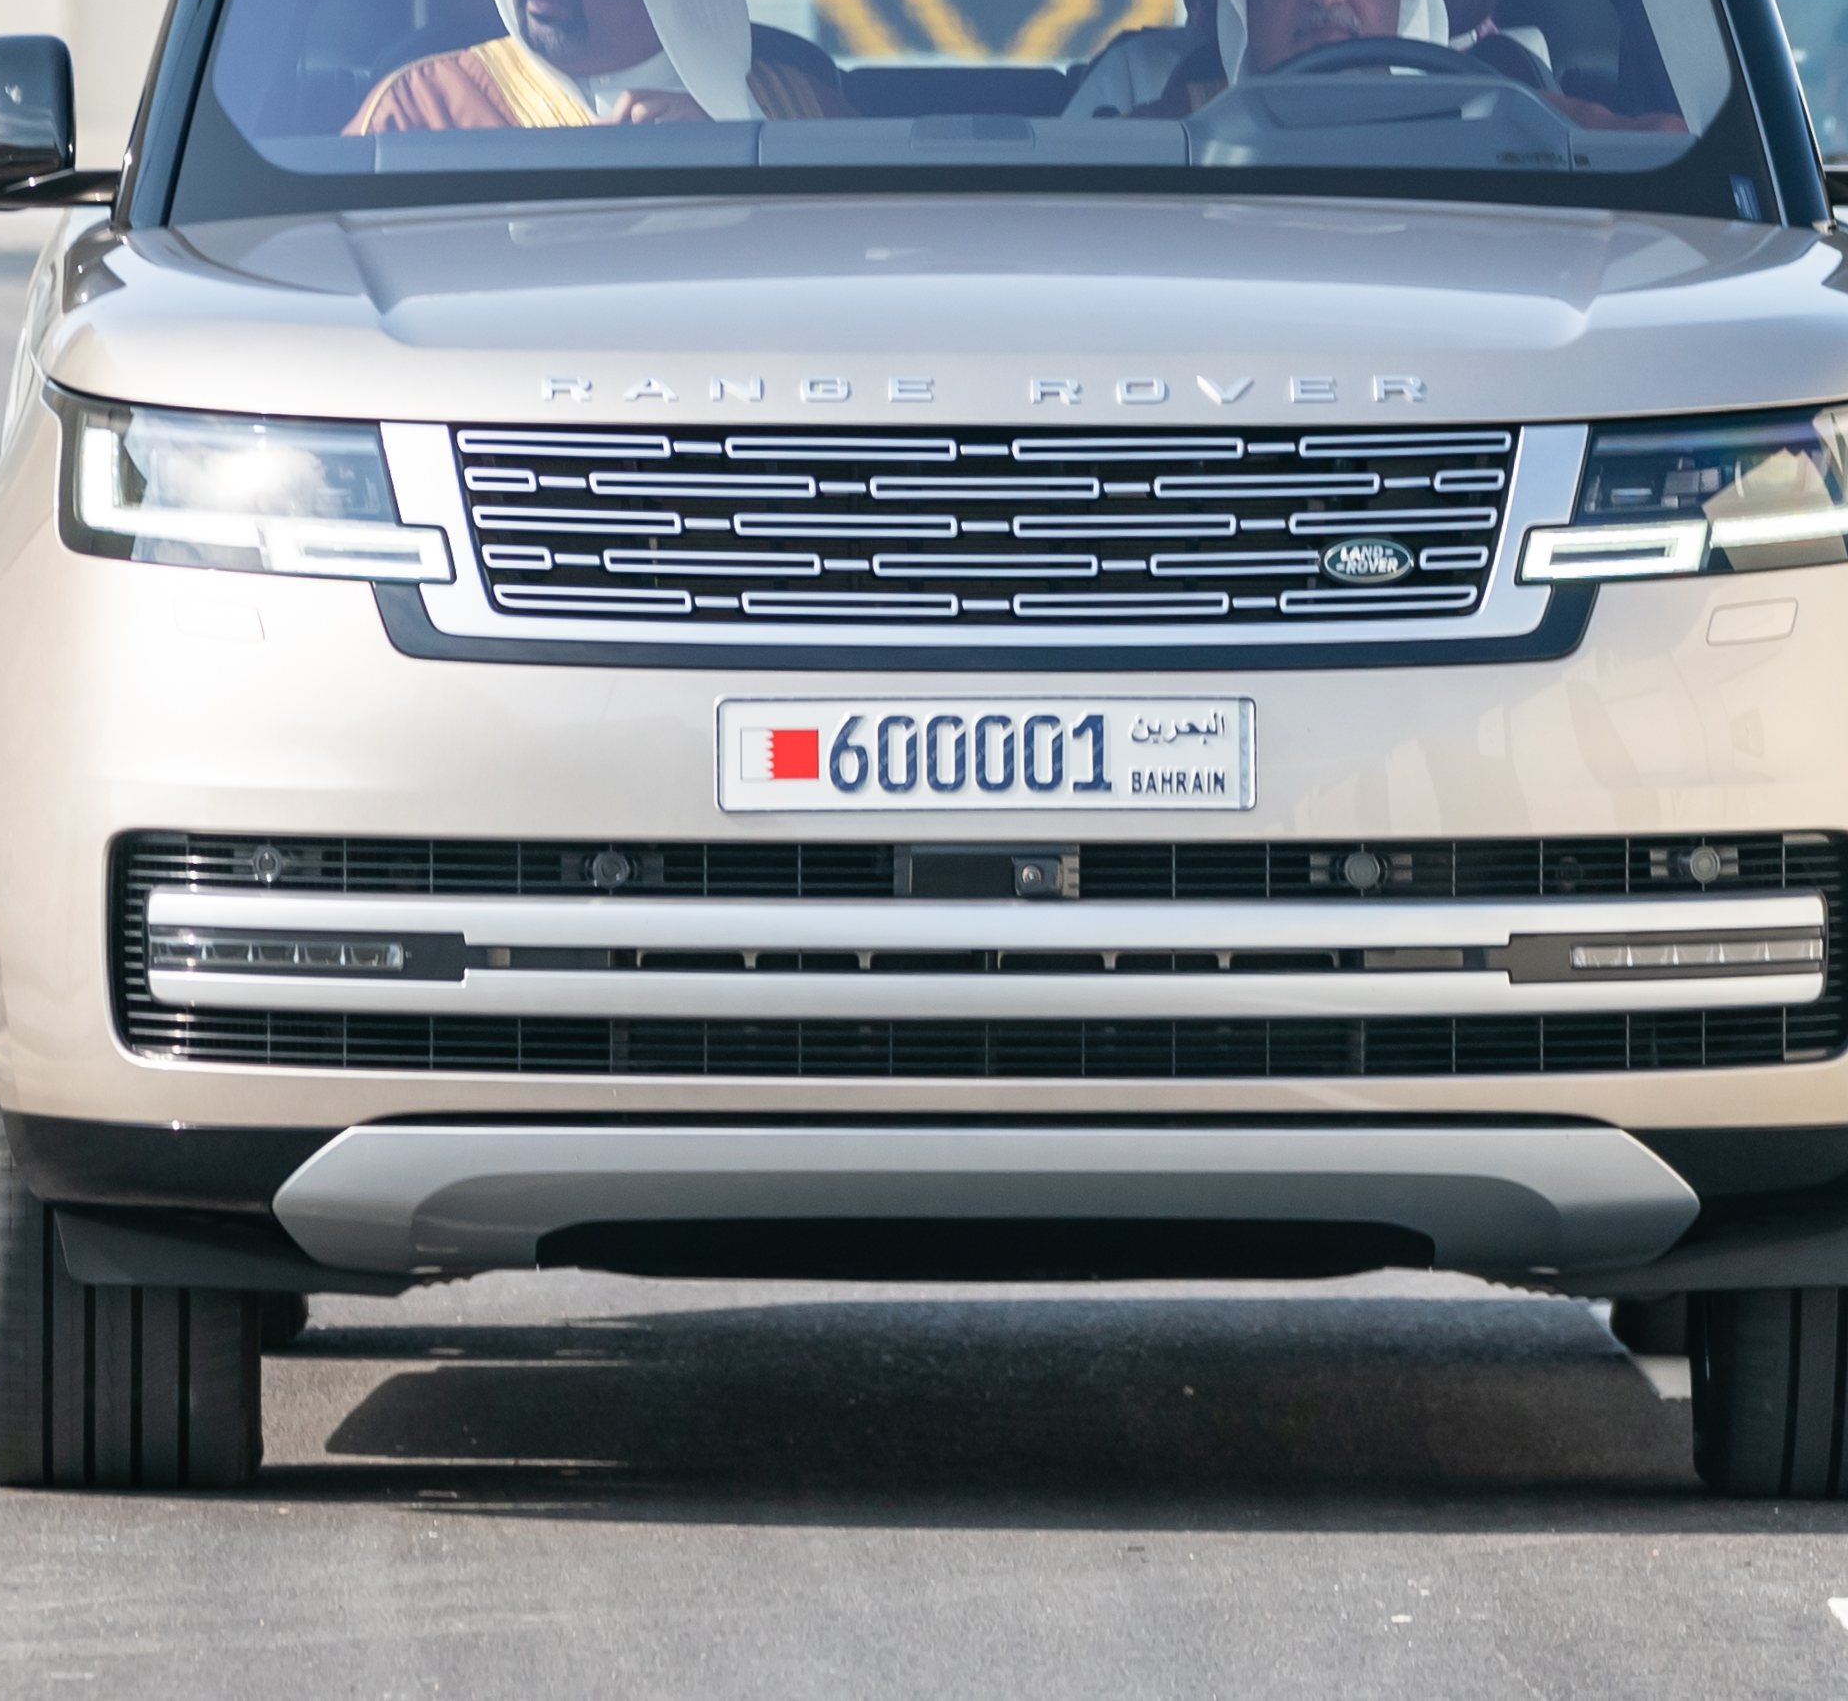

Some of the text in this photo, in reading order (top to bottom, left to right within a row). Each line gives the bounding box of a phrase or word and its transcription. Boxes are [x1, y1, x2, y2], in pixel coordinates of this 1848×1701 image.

[540, 374, 1427, 405] RANGE ROVER
[1339, 544, 1384, 562] LAND
[1345, 556, 1399, 575] ROVER
[1130, 711, 1225, 746] البحرين
[828, 713, 1113, 794] 600001
[1131, 771, 1226, 795] BAHRAIN
